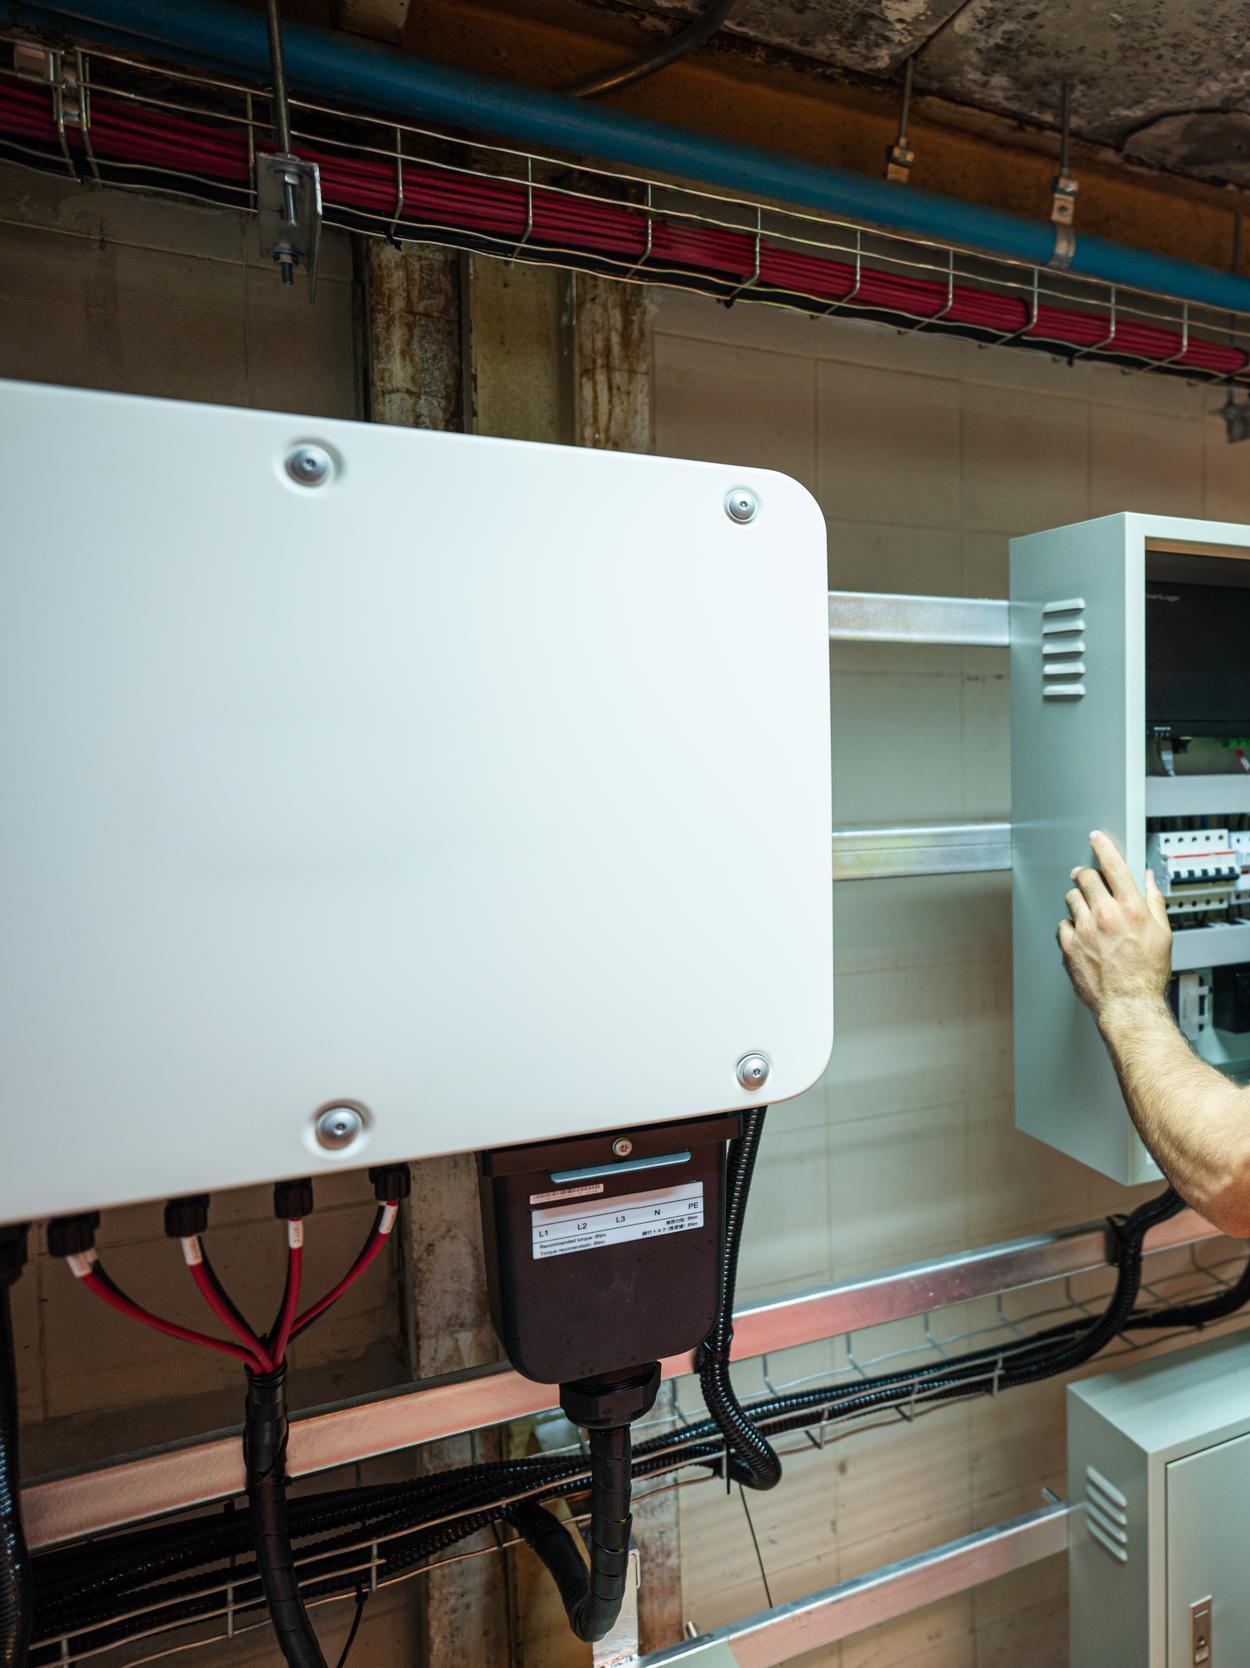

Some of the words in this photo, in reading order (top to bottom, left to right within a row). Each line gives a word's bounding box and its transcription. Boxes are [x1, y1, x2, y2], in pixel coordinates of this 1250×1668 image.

[539, 1229, 549, 1238] L1
[577, 1222, 588, 1231] L2
[615, 1215, 626, 1224] L3
[688, 1201, 699, 1210] PE
